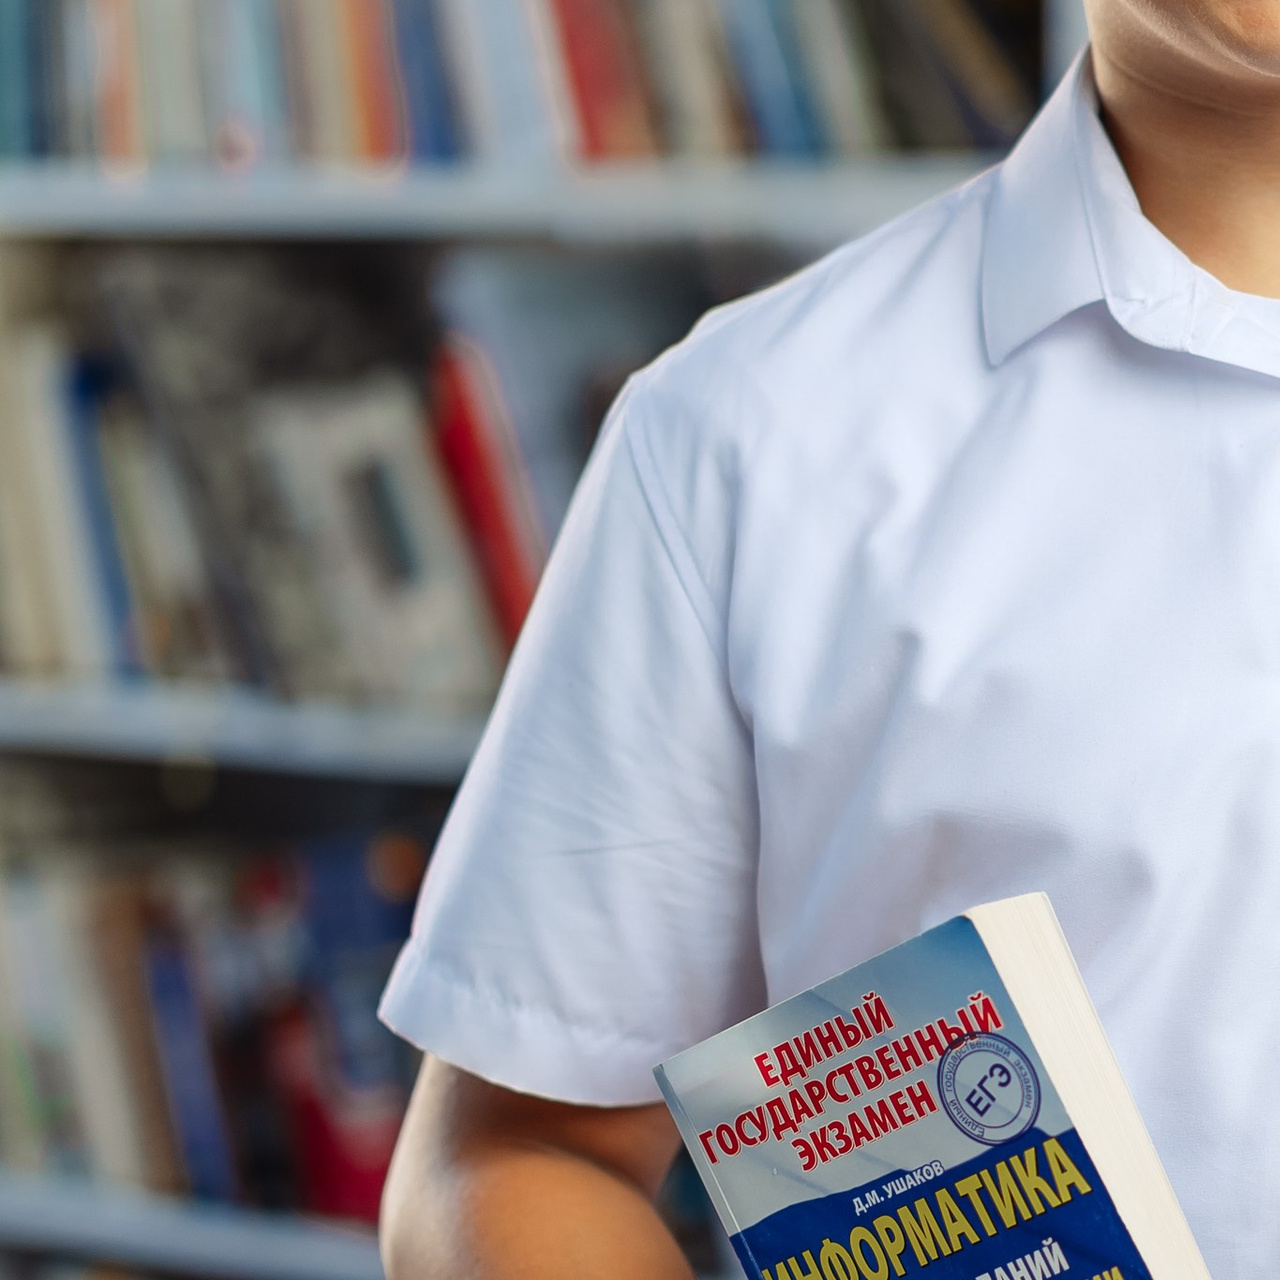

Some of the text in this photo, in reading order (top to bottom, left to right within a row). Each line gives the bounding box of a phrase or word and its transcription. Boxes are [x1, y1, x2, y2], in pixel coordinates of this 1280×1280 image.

[699, 991, 1003, 1164] ГОСУДАРСТВЕННЫЙ
[754, 991, 895, 1088] ЕДИНЫЙ
[791, 1081, 938, 1171] ЭКЗАМЕН
[965, 1063, 1011, 1117] ЕГЭ
[852, 1160, 945, 1216] Д.М. УШАКОВ
